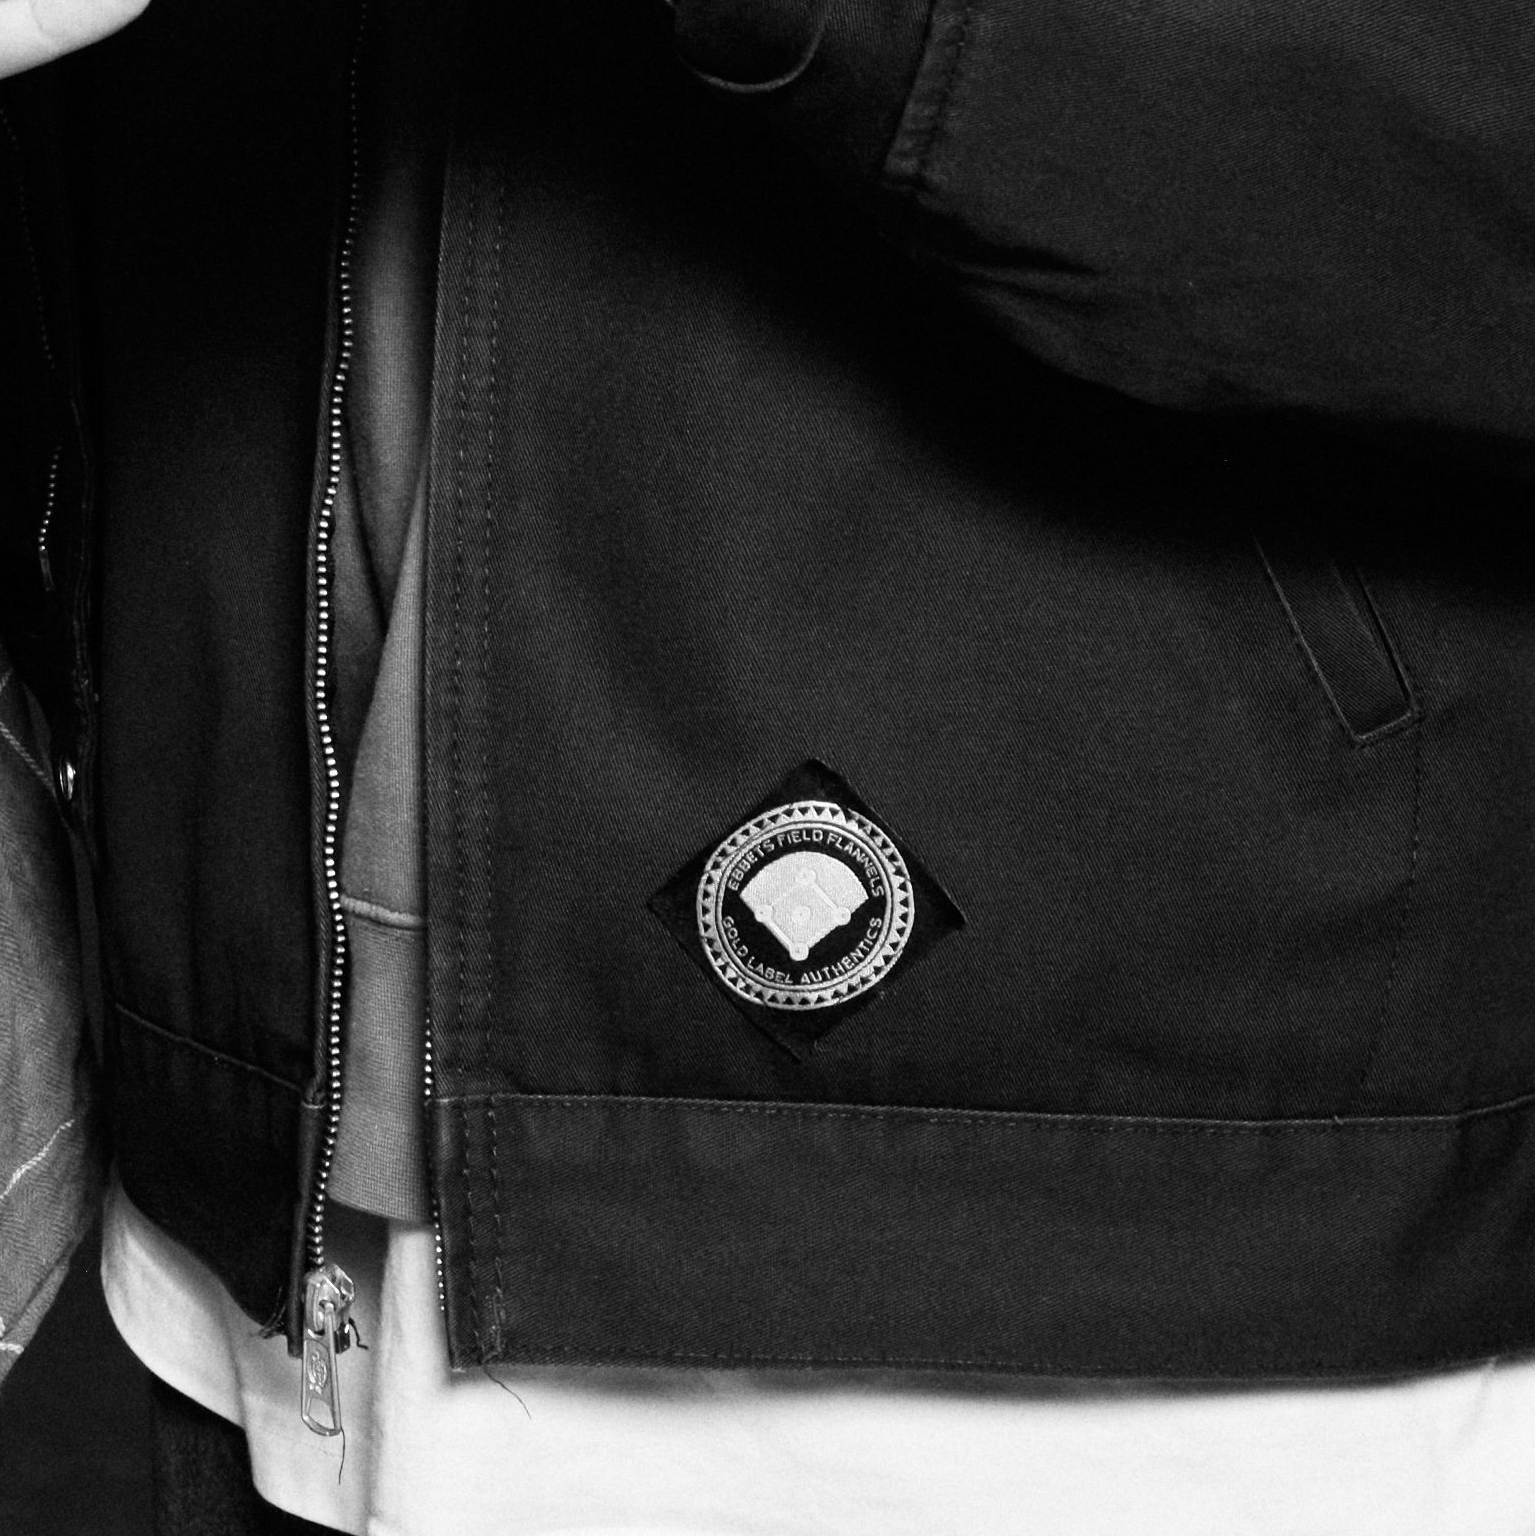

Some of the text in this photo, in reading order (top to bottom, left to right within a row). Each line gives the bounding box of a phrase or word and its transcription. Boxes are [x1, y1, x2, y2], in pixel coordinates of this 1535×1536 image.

[728, 829, 885, 897] EBBETS FIELD FLANNELS
[722, 916, 882, 984] GOLD LABEL AUTHENTICS
